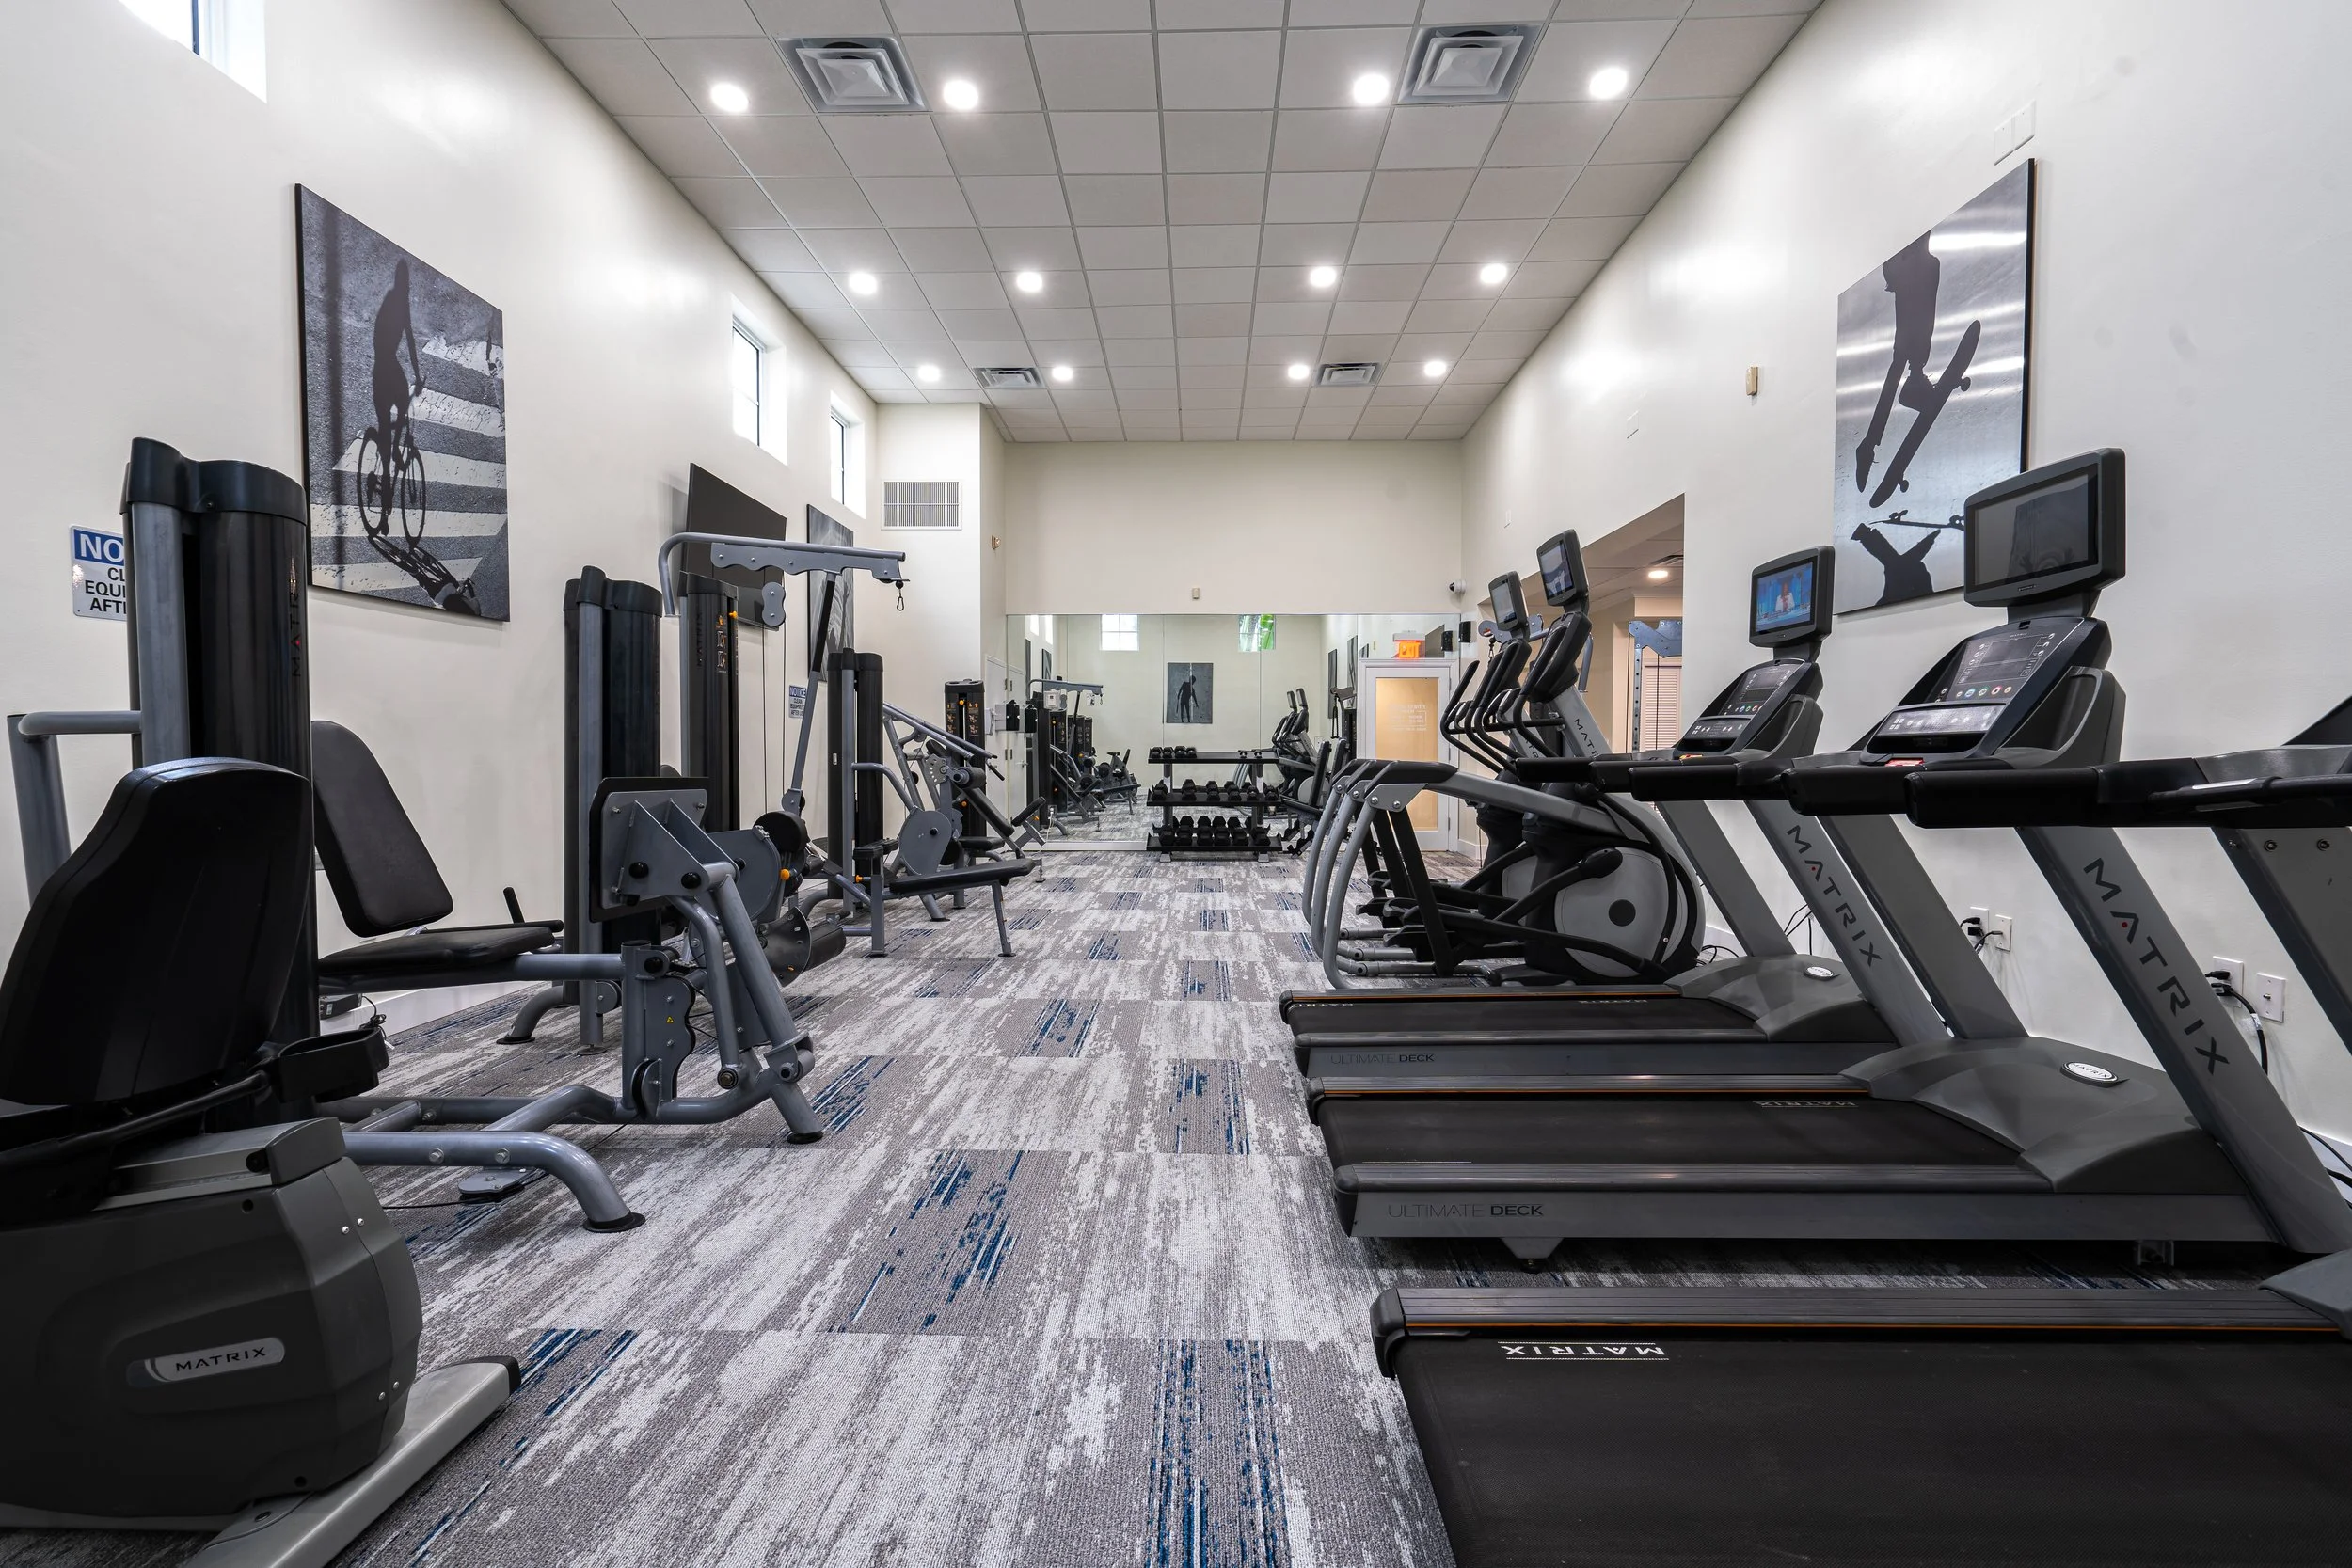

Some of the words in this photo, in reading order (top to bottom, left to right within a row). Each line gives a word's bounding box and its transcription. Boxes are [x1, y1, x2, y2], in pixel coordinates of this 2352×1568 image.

[1787, 824, 1882, 968] MATRIX
[2083, 857, 2231, 1075] MATRIX
[1330, 1053, 1395, 1065] ULTIMATE
[1398, 1053, 1435, 1063] DECK
[1388, 1204, 1484, 1218] ULTIMATE
[1489, 1204, 1544, 1216] DECK
[175, 1346, 267, 1372] MATRIX
[1501, 1346, 1665, 1355] MATRIX
